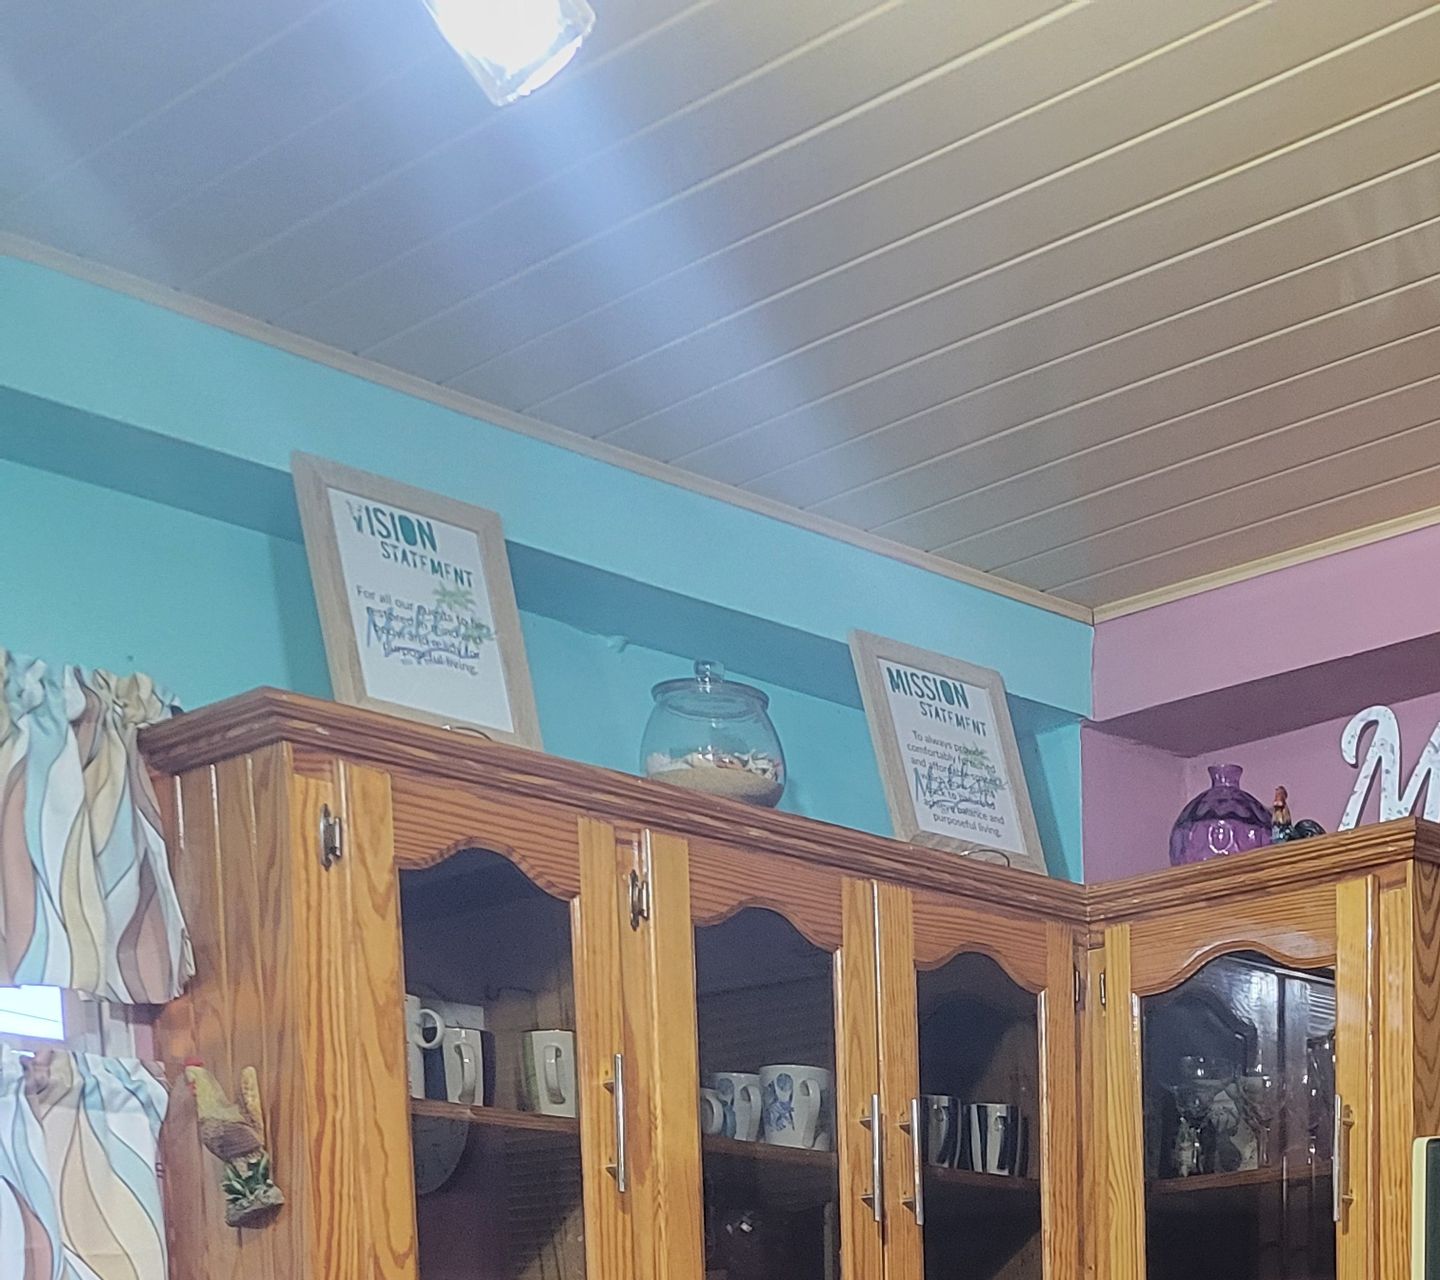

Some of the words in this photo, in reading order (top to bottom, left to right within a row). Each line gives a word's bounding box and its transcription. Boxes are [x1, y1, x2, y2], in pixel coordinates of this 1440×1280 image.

[347, 501, 437, 552] VISION
[380, 541, 473, 588] STATEMENT
[356, 585, 376, 600] For
[394, 598, 413, 611] our
[886, 667, 968, 709] MISSION
[920, 701, 986, 736] STATEMENT
[912, 730, 923, 742] To
[910, 756, 927, 767] and
[988, 813, 1005, 825] and
